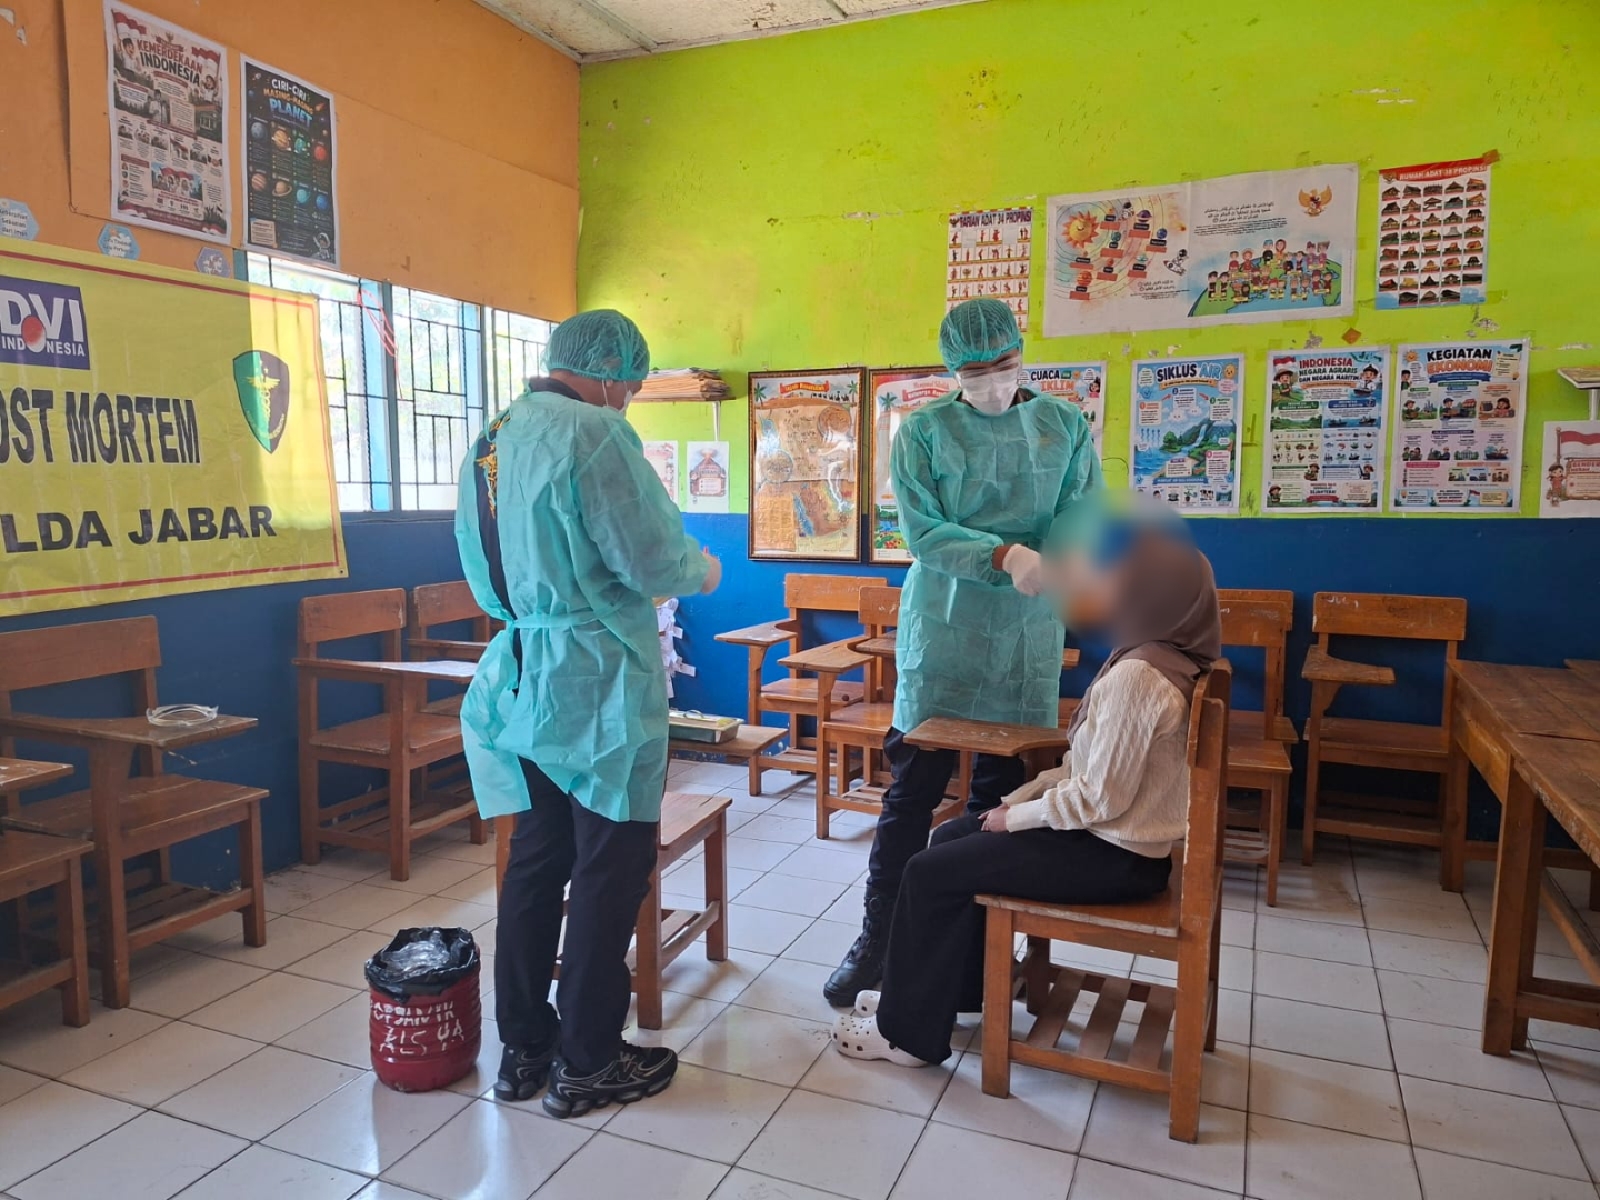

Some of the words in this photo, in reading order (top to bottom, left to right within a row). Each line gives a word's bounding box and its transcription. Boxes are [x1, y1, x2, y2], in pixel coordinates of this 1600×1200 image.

[140, 51, 200, 87] INDONESIA
[269, 98, 313, 127] PLANET
[0, 289, 84, 342] DVI
[1299, 357, 1353, 369] INDONESIA
[1427, 348, 1492, 361] KEGIATAN
[1031, 370, 1060, 381] CUACA
[1157, 363, 1197, 382] SIKLUS
[1200, 362, 1221, 380] AIR
[1299, 367, 1328, 376] NEGARA
[1427, 360, 1492, 374] EKONOMI
[1041, 380, 1075, 392] IKLIM
[66, 391, 200, 464] MORTEM
[128, 506, 277, 545] JABAR
